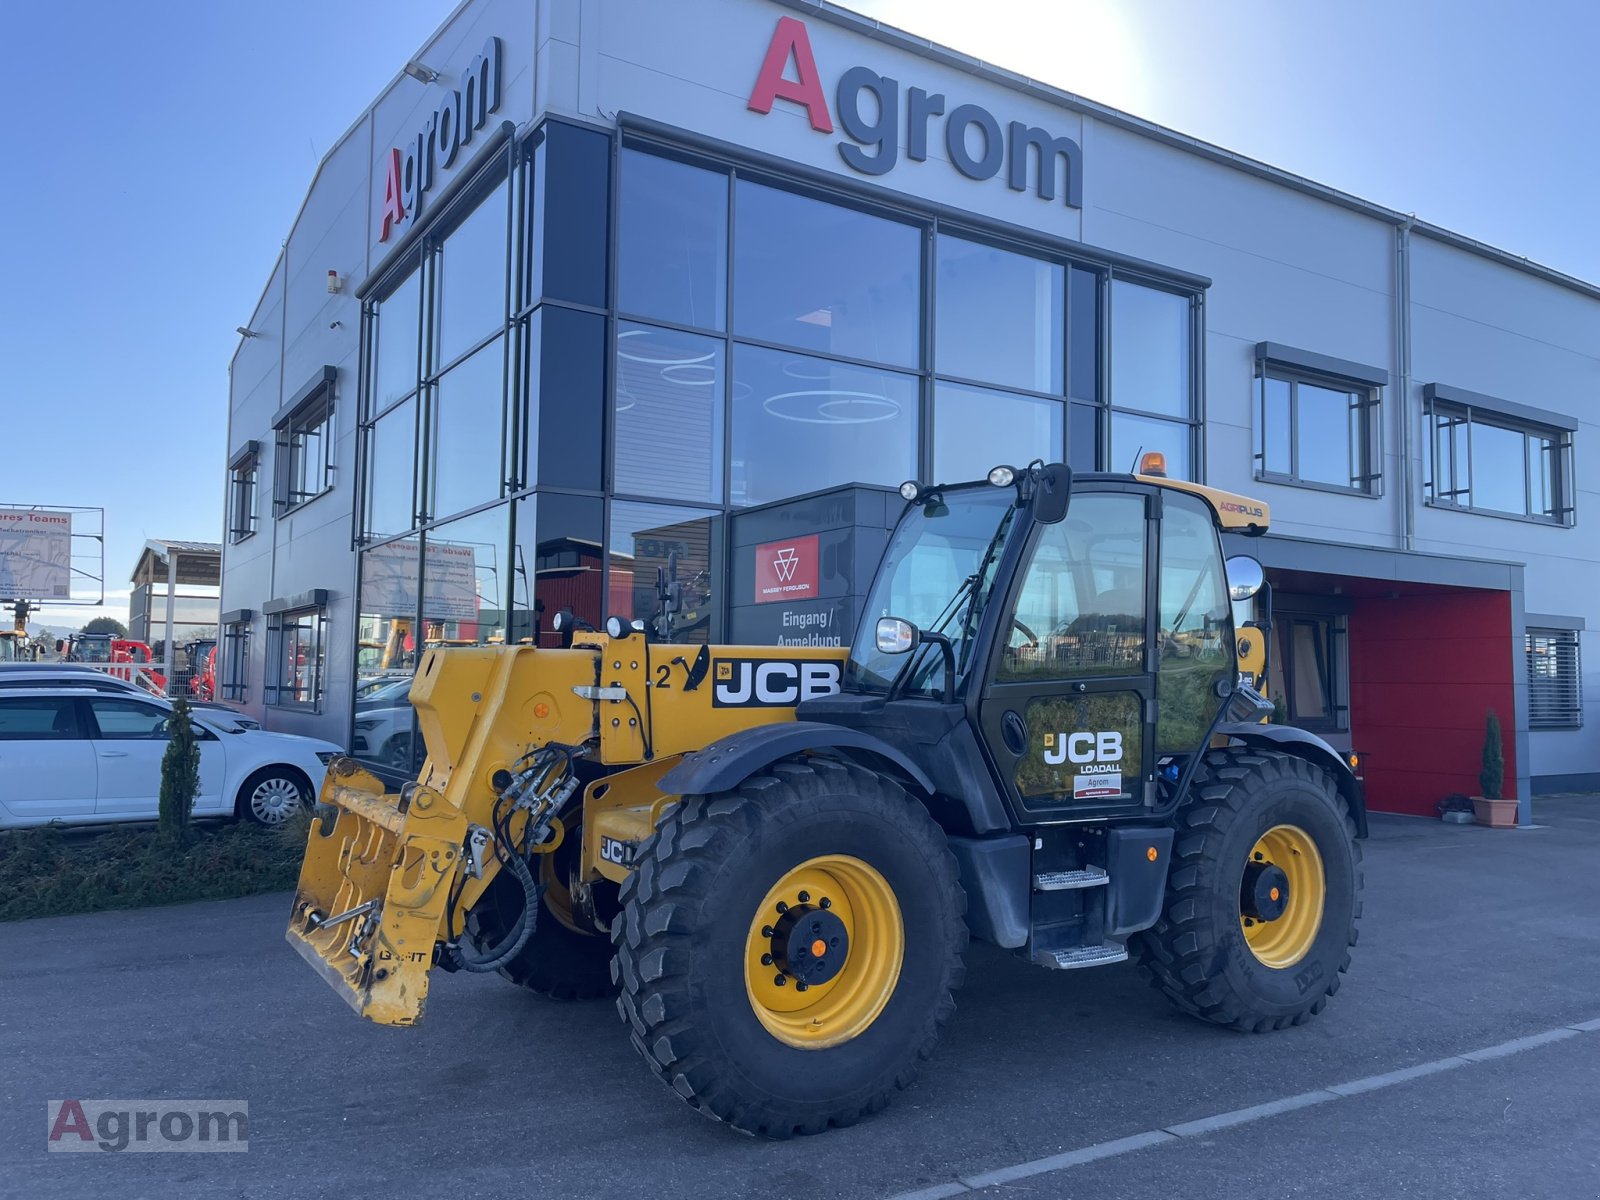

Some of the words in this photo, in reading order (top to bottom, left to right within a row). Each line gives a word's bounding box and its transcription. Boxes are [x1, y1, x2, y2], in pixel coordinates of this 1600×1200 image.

[747, 16, 1083, 209] Agrom
[379, 36, 501, 242] Agrom
[28, 513, 68, 524] Teams
[1220, 502, 1263, 517] AGRIPLUS
[762, 586, 782, 594] MASSEY
[783, 583, 810, 592] FERGUSON
[777, 633, 841, 647] Anmeldung
[656, 665, 671, 689] 2
[716, 662, 841, 703] JCB
[1044, 731, 1122, 765] JCB
[1080, 764, 1122, 774] LOADALL
[1087, 778, 1109, 787] Agrom
[602, 839, 624, 863] JC
